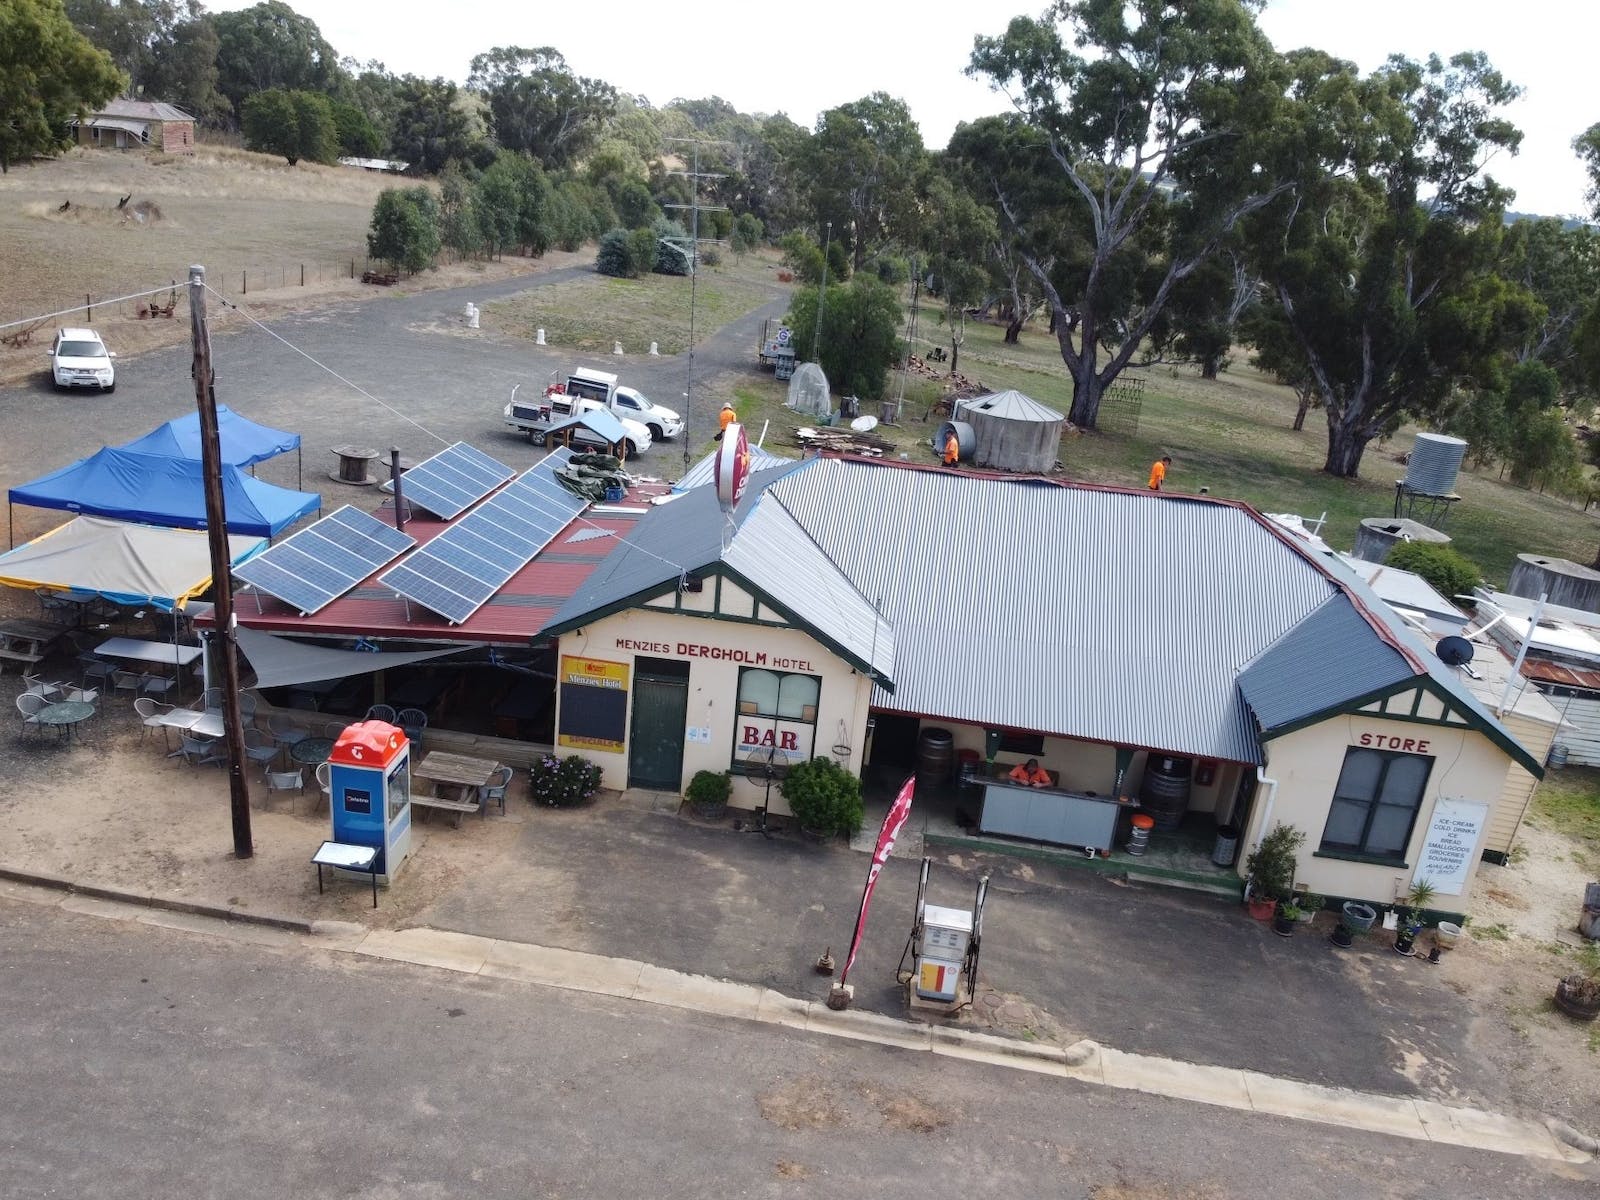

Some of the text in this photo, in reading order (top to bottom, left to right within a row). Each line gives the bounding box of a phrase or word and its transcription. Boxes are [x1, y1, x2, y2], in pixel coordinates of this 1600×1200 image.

[616, 638, 815, 672] MENZIES DERGHOLM HOTEL
[569, 674, 622, 689] Menzies Hotel
[742, 726, 798, 750] BAR
[1360, 733, 1430, 753] STORE
[1439, 818, 1475, 827] ICE-CREAM
[1428, 842, 1470, 853] SMALLGOODS
[1429, 849, 1465, 858] GROCERIES
[1427, 855, 1463, 864] SOUVENIRS
